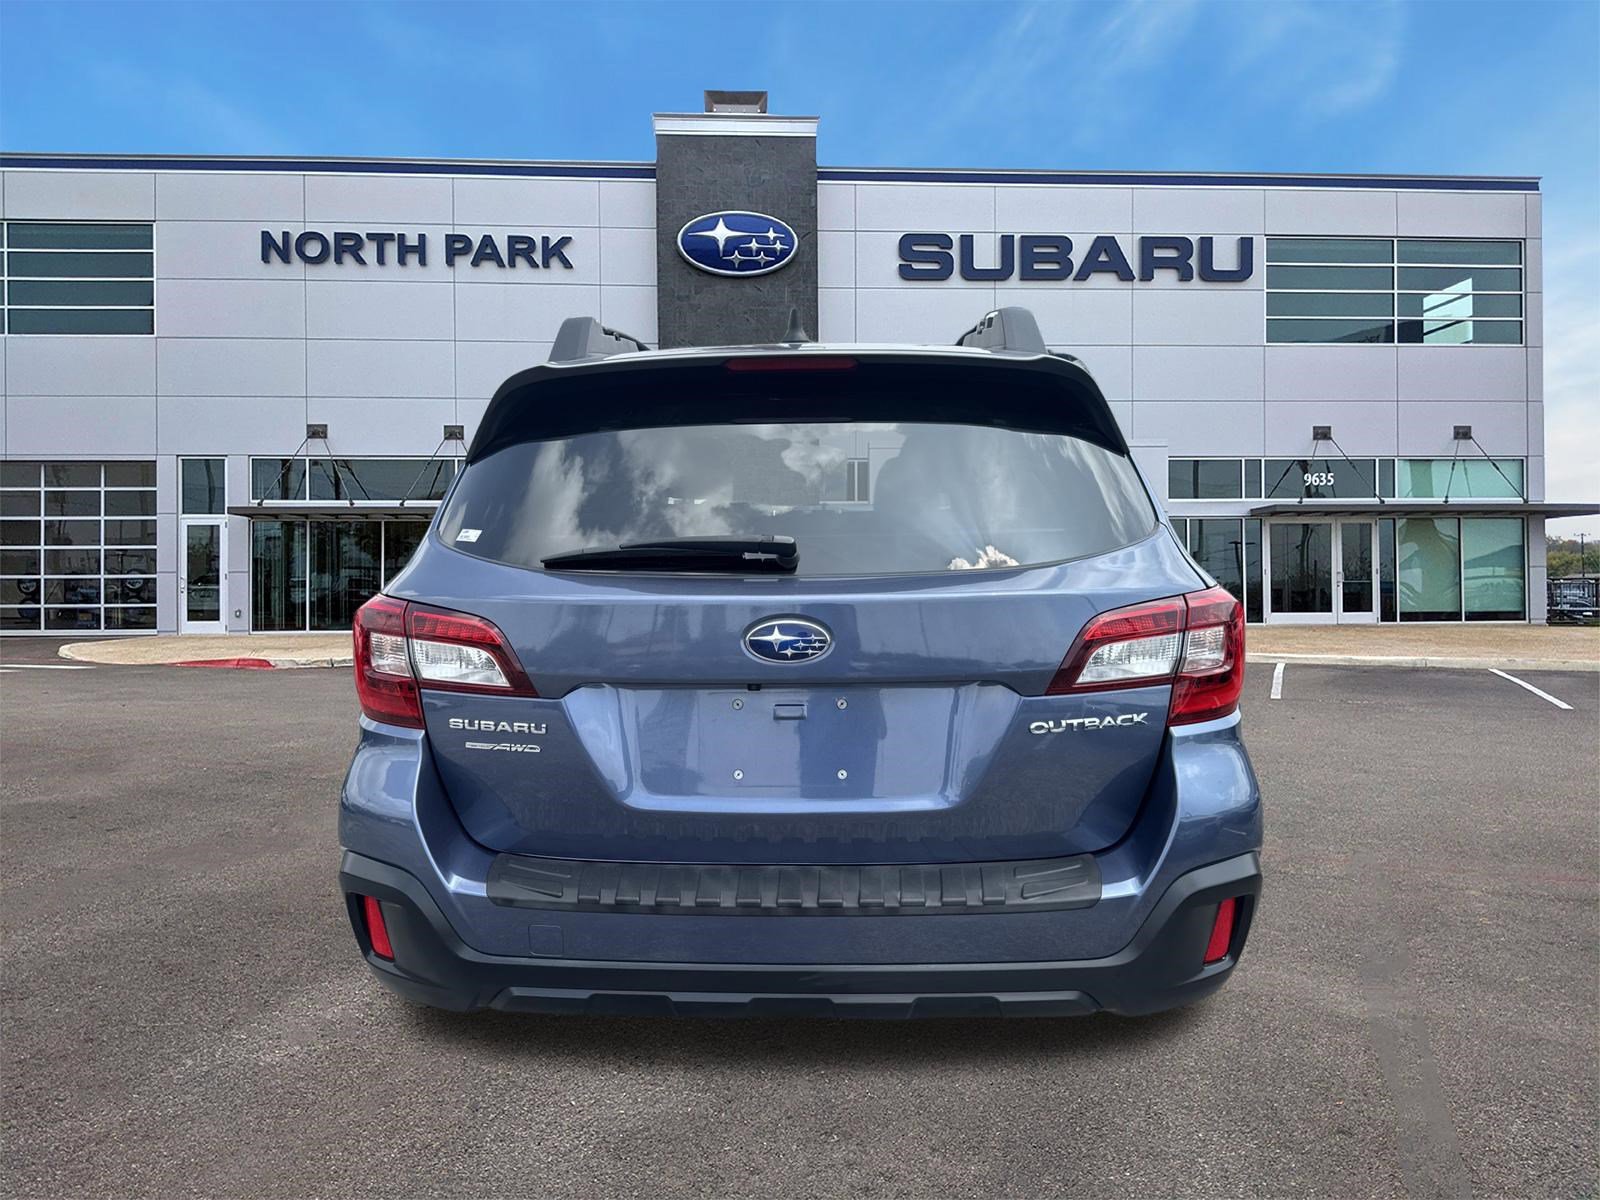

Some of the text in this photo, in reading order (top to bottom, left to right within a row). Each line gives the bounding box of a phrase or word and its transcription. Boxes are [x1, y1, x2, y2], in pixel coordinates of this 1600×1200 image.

[261, 230, 574, 269] NORTH PARK
[898, 233, 1254, 282] SUBARU
[1303, 472, 1335, 486] 9635
[448, 718, 547, 734] SUBARU
[1029, 712, 1149, 734] OUTBACK
[492, 743, 541, 753] AWD
